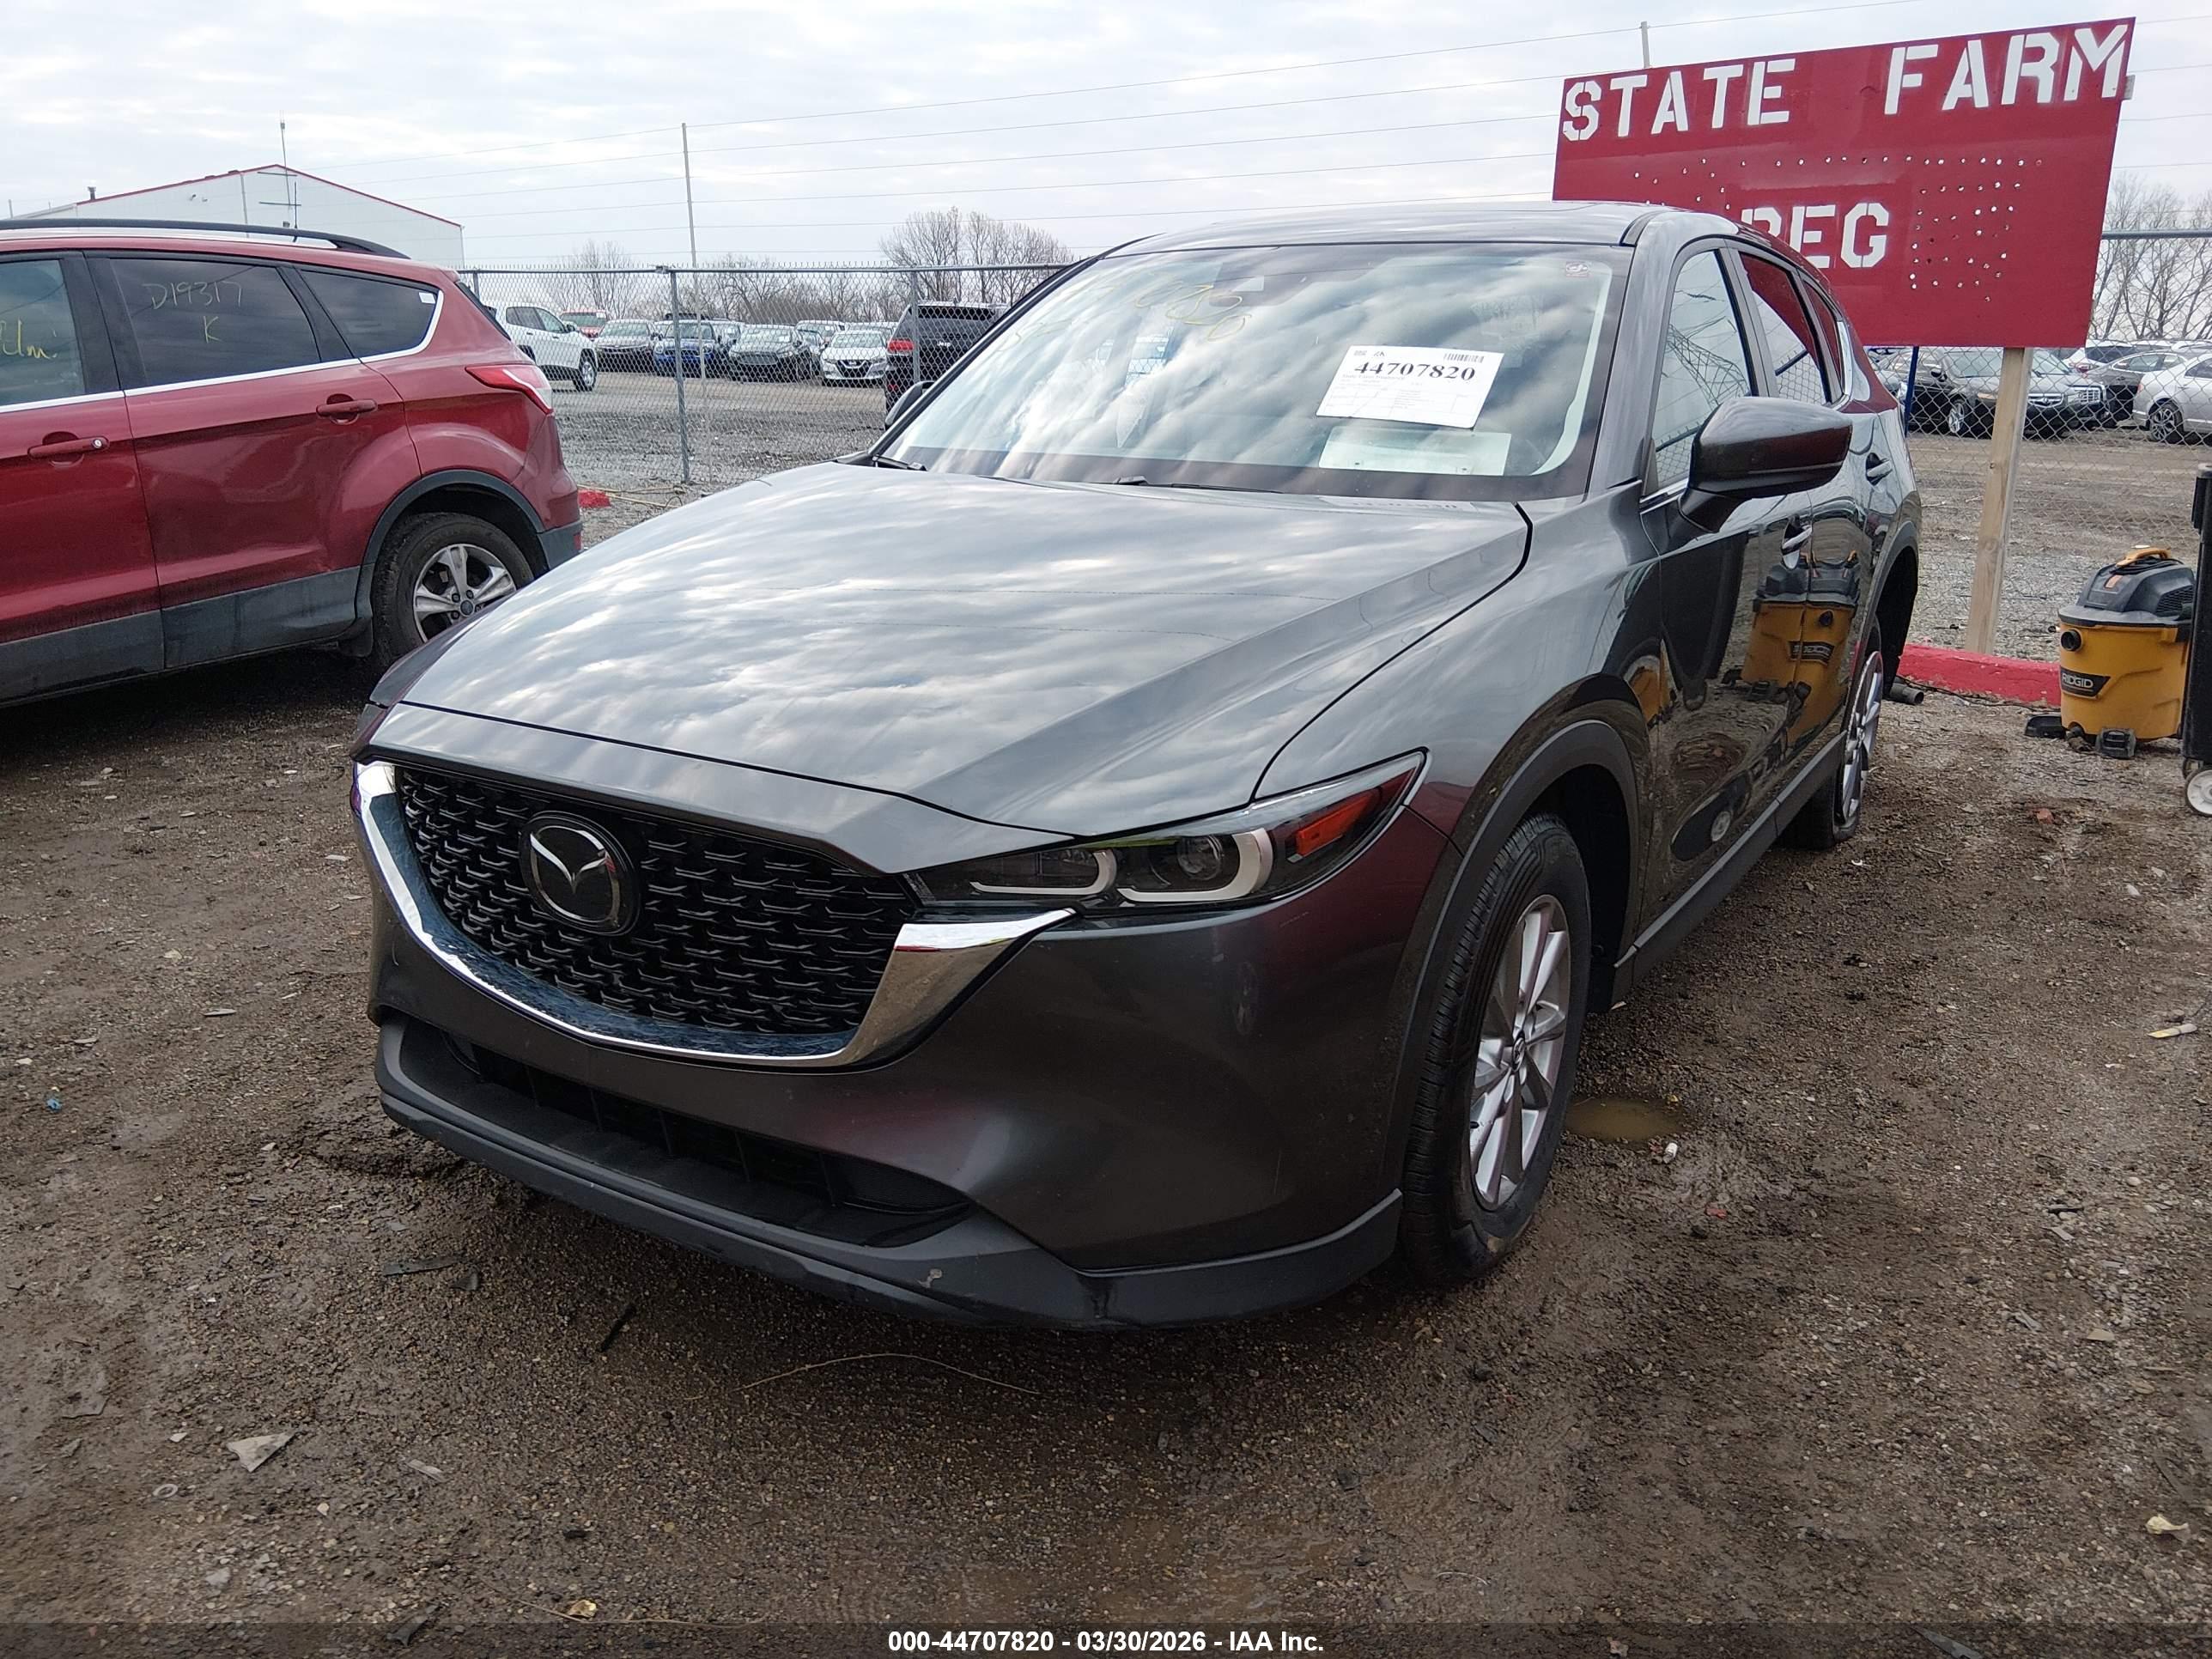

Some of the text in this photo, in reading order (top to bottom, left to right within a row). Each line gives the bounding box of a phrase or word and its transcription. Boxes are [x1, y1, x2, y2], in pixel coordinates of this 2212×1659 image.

[1562, 24, 2129, 142] STATE FARM
[203, 315, 223, 343] K
[1354, 362, 1475, 380] 44707820
[2062, 673, 2094, 688] RIDGID
